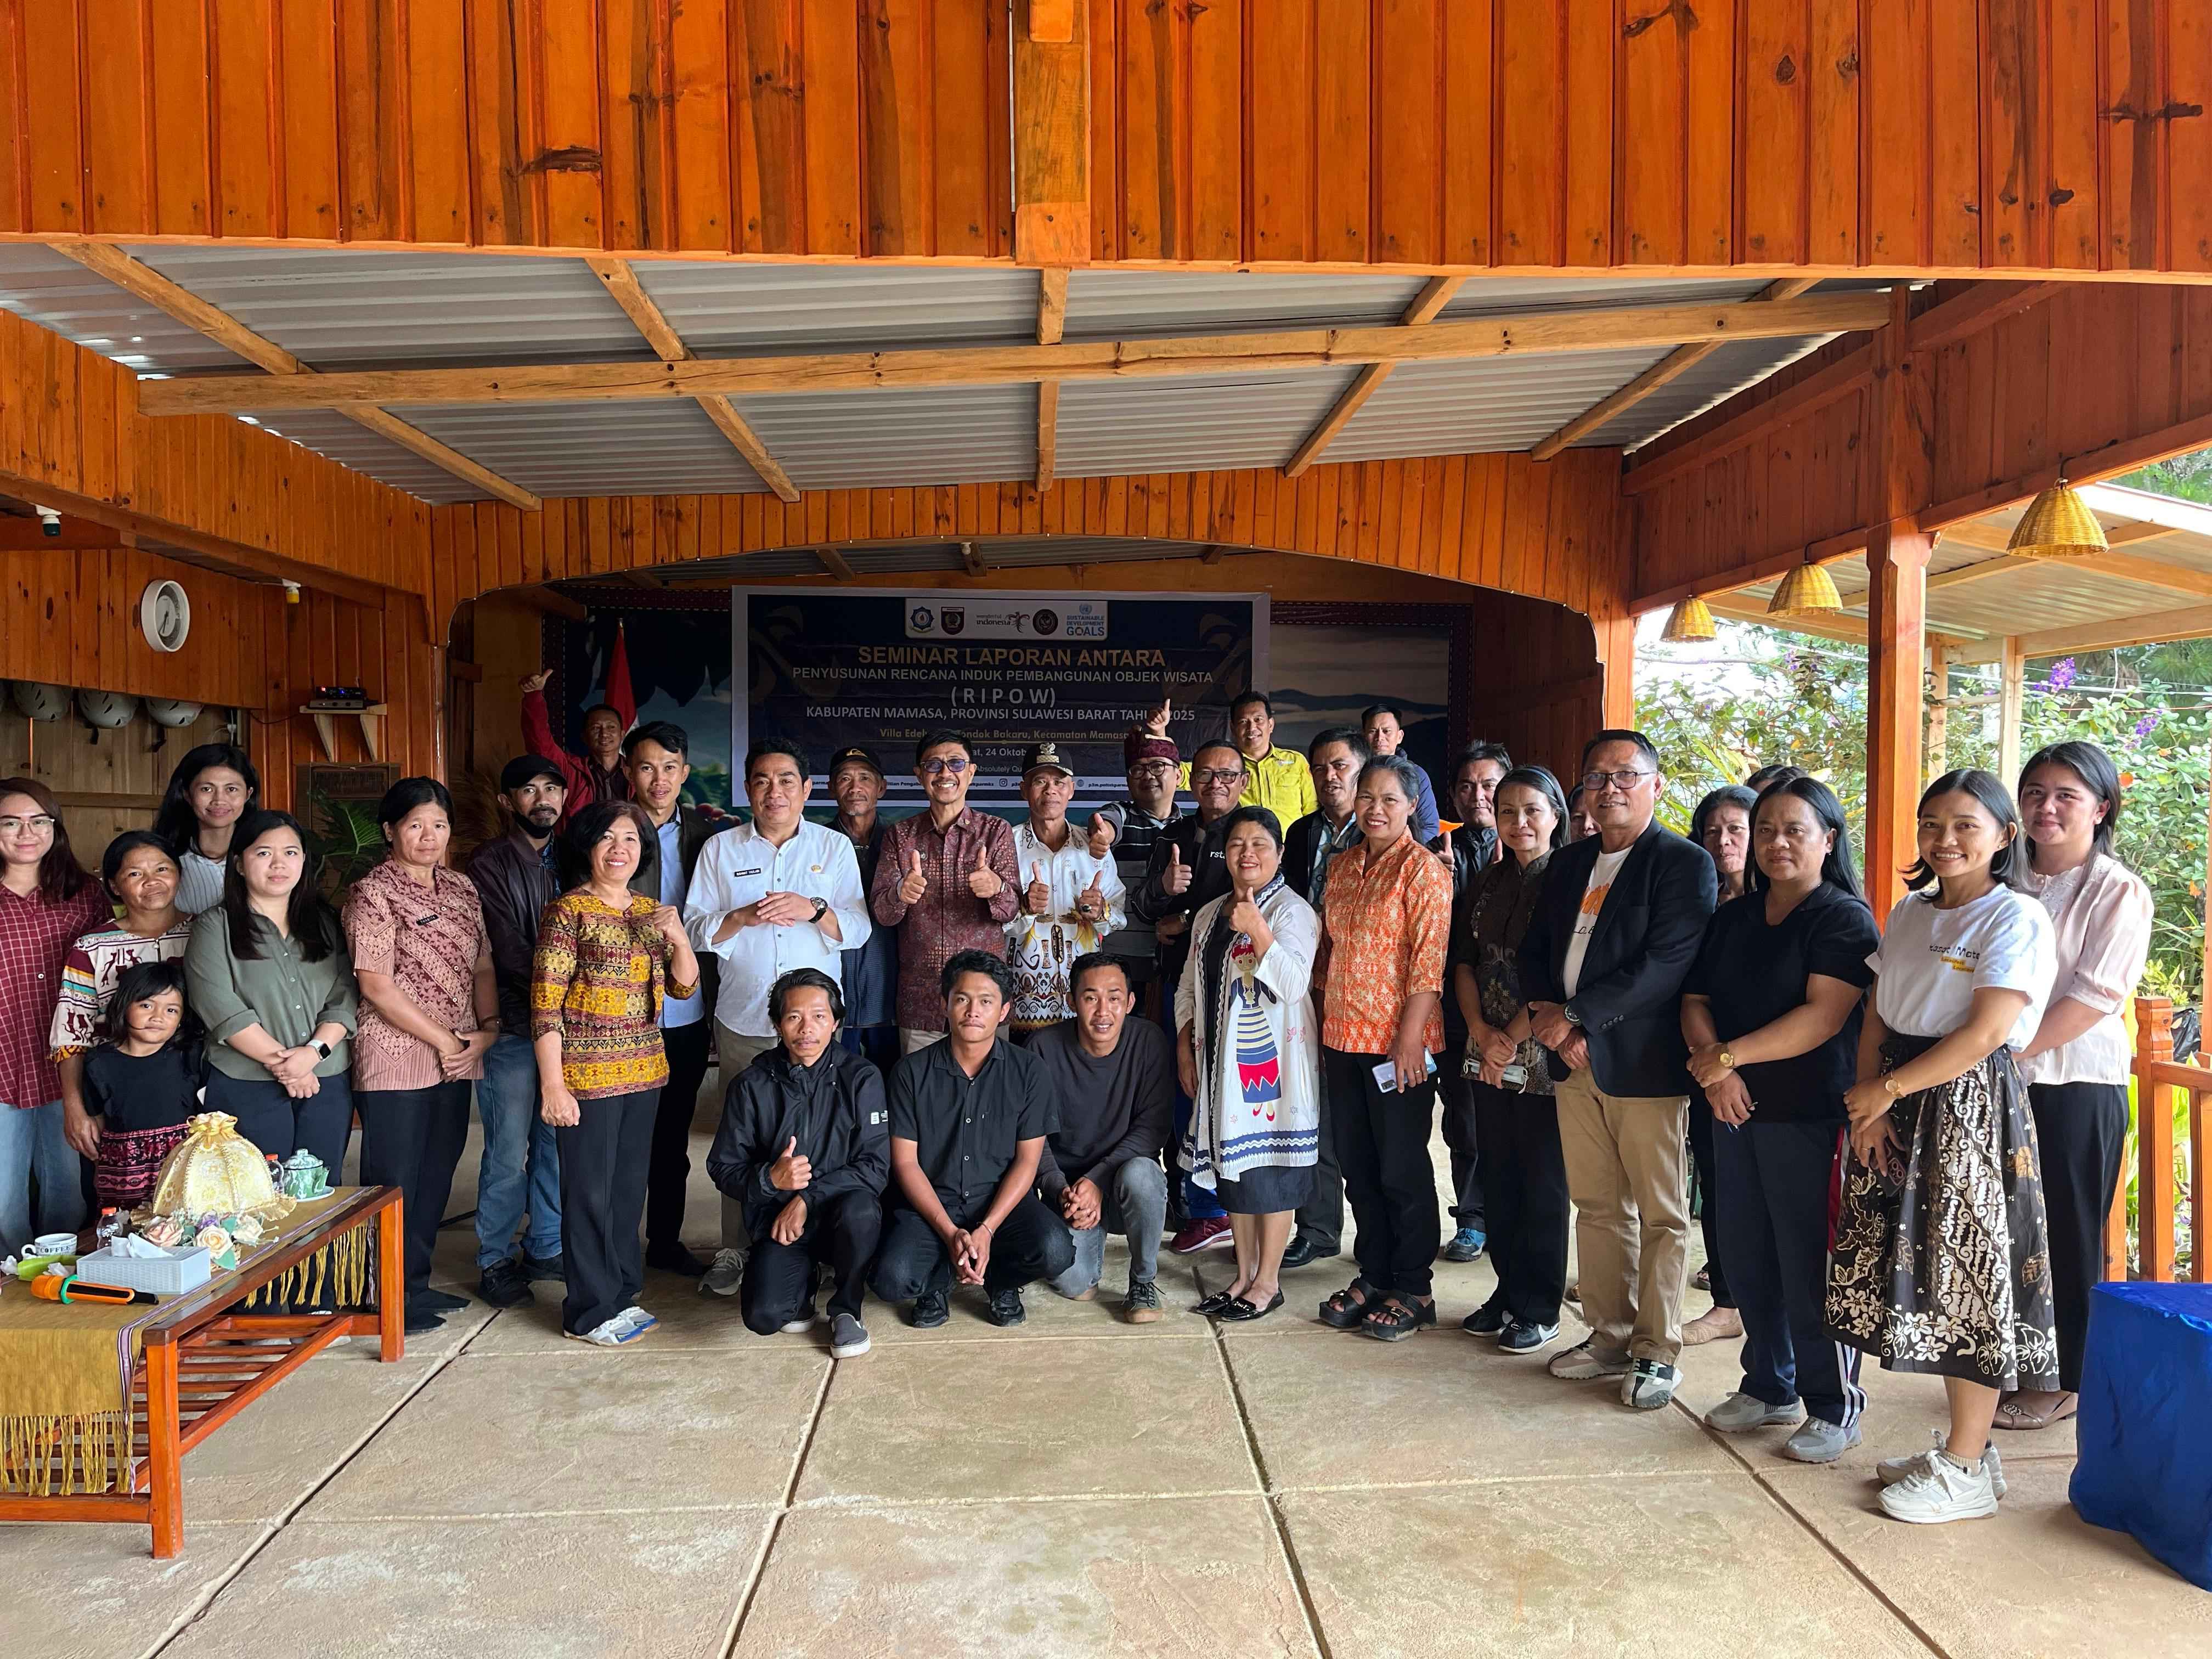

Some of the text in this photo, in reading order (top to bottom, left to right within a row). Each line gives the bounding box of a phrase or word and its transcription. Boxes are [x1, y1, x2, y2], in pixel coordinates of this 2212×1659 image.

[1066, 627, 1104, 636] GOALS
[859, 646, 1166, 667] SEMINAR LAPORAN ANTARA
[793, 667, 1213, 682] PENYUSUNAN RENCANA INDUK PEMBANGUNAN OBJEK WISATA
[806, 707, 880, 718] KABUPATEN
[884, 707, 946, 720] MAMASA,
[951, 708, 1008, 719] PROVINSI
[1012, 709, 1073, 720] SULAWESI
[1077, 709, 1116, 720] BARAT
[1120, 710, 1147, 720] TAH
[880, 729, 901, 737] Villa
[994, 730, 1030, 739] Bakaru,
[1034, 730, 1087, 738] Kecamatan
